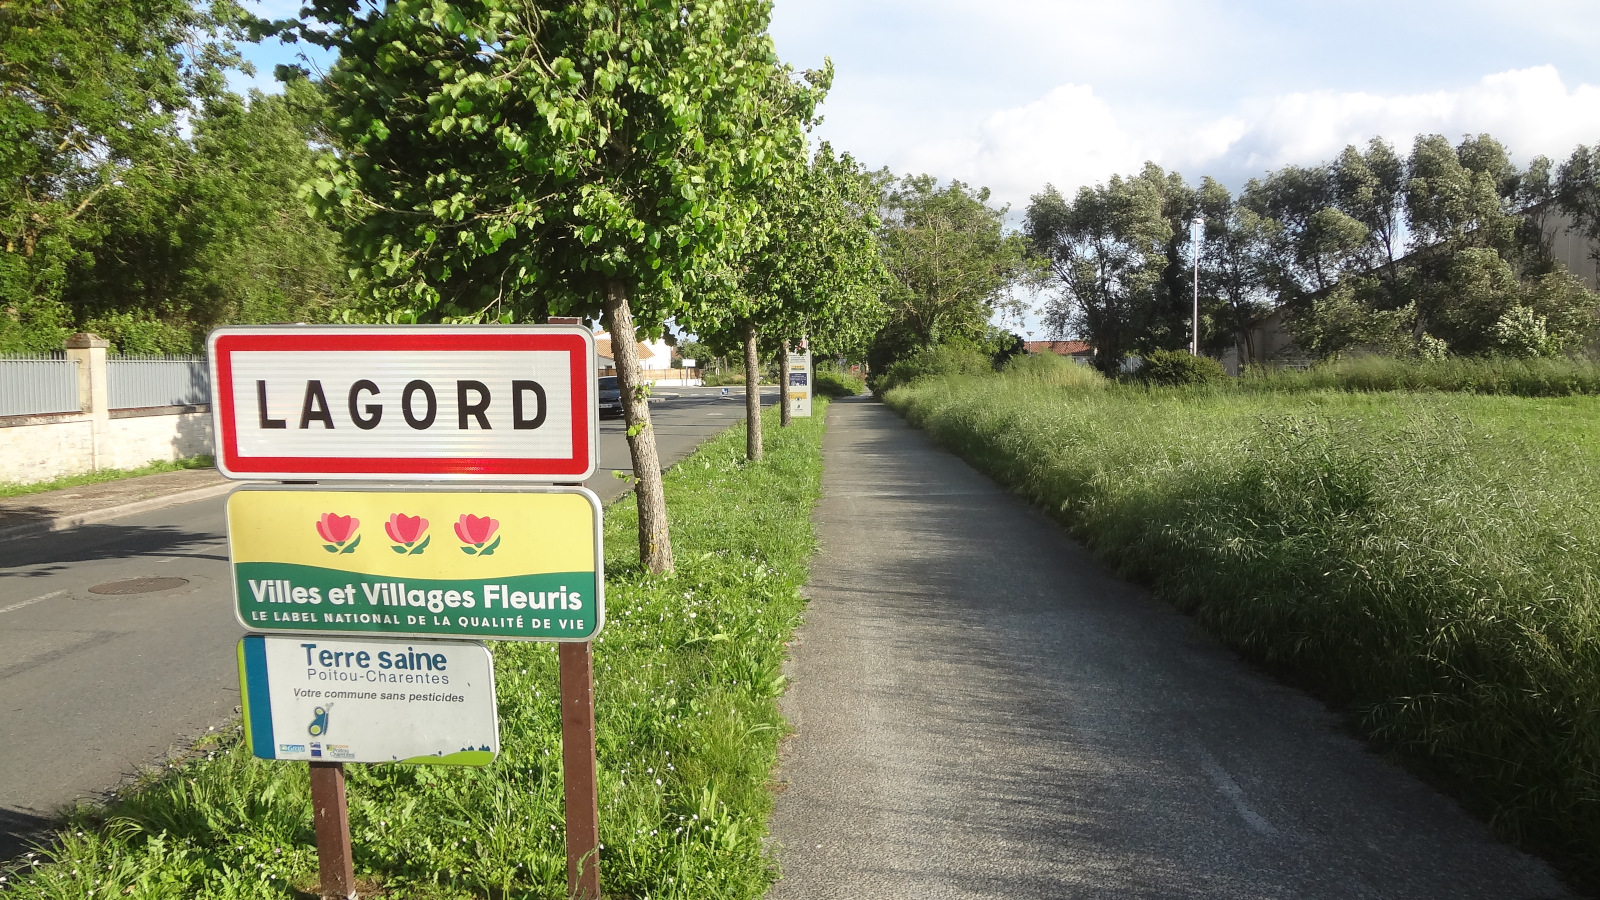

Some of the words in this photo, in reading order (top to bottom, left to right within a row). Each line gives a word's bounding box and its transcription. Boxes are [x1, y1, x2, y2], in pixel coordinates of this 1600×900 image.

[256, 379, 546, 430] LAGORD
[248, 579, 321, 604] Villes
[328, 584, 355, 604] et
[361, 583, 475, 613] Villages
[484, 585, 582, 610] Fleuris
[252, 611, 268, 621] LE
[274, 611, 318, 623] LABEL
[324, 613, 400, 625] NATIONAL
[407, 614, 426, 626] DE
[434, 615, 451, 627] LA
[459, 615, 524, 629] QUALITÉ
[532, 618, 551, 629] DE
[559, 619, 584, 630] VIE
[300, 643, 370, 668] Terre
[378, 647, 447, 671] saine
[307, 669, 449, 685] Poitou-Charentes
[293, 687, 321, 698] Votre
[324, 690, 377, 700] commune
[380, 692, 406, 701] sans
[409, 692, 464, 703] pesticides
